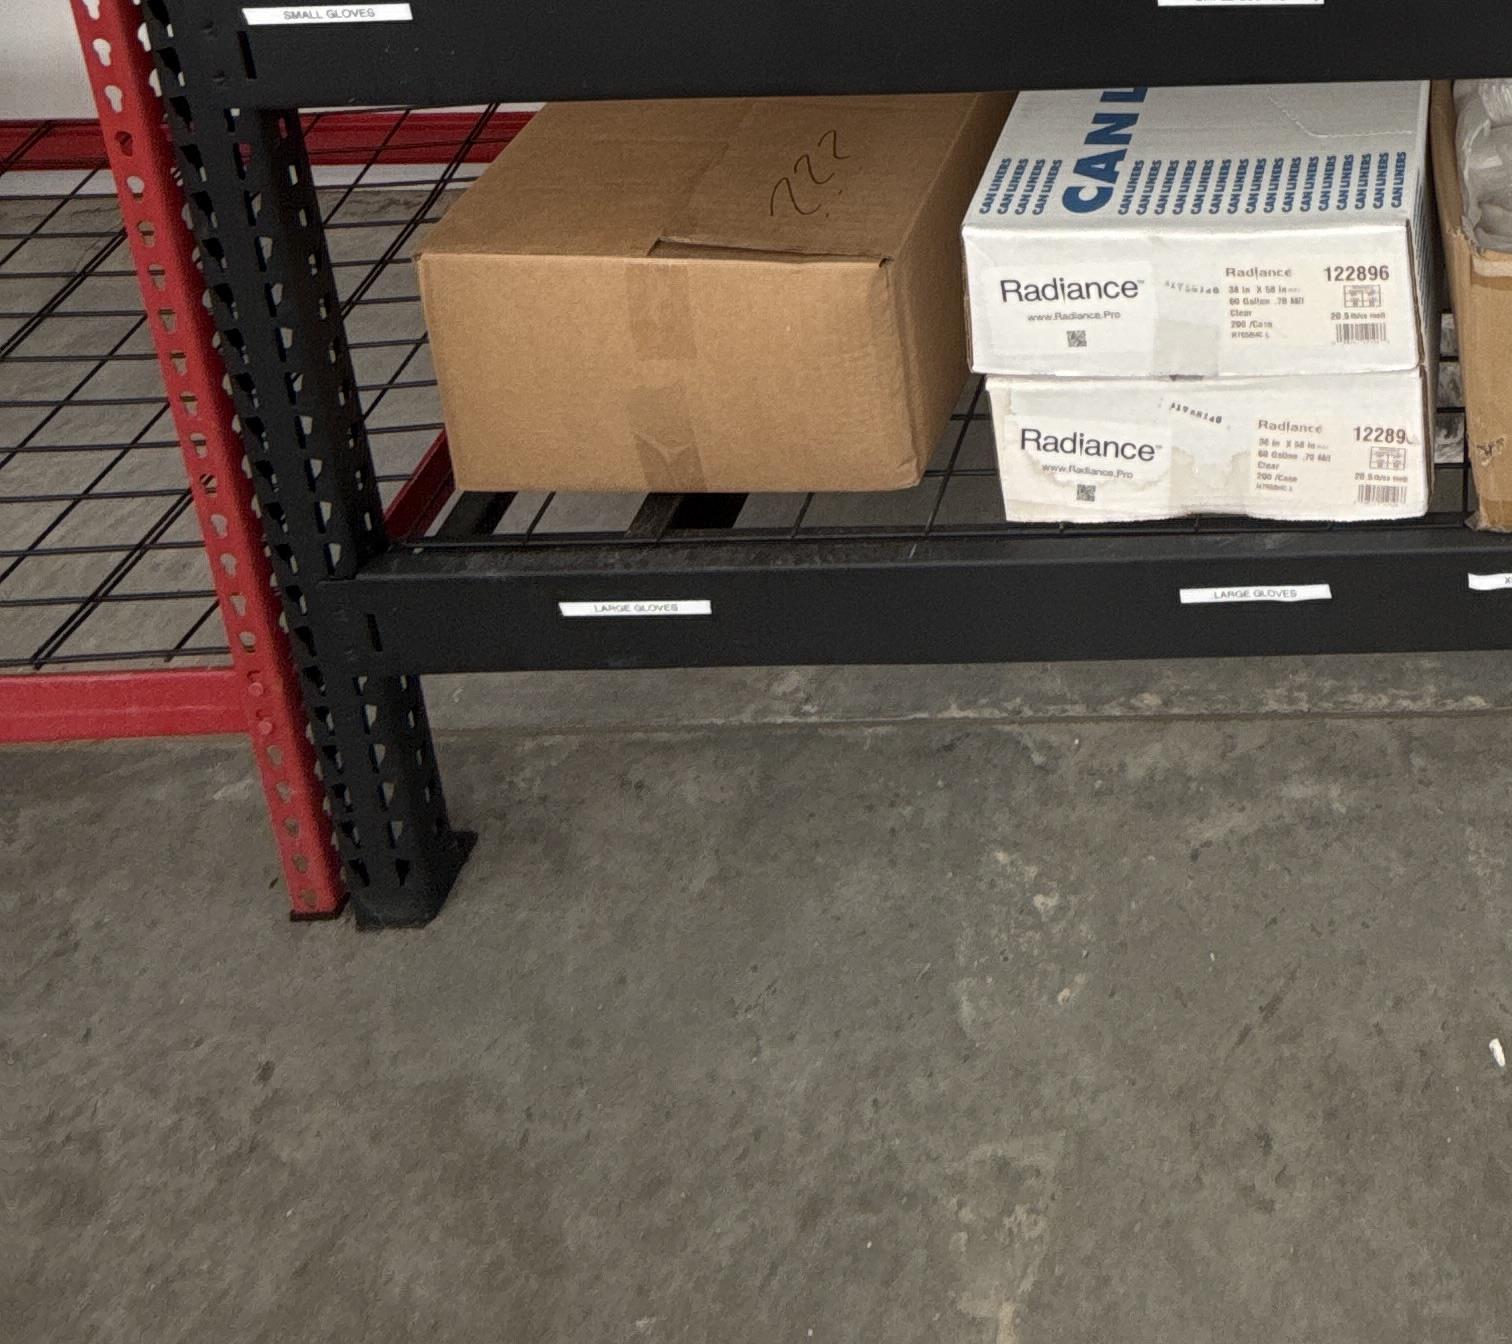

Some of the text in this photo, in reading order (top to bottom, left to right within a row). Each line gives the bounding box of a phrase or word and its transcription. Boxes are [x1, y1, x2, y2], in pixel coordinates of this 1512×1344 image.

[284, 8, 376, 20] SMALL GLOVES
[979, 158, 1012, 214] CAN LINERS
[997, 158, 1029, 214] CAN LINERS
[1015, 159, 1045, 215] CAN LINERS
[1032, 159, 1062, 215] CAN LINERS
[1062, 113, 1140, 214] CAN
[1118, 160, 1144, 215] CAN LINERS
[1136, 160, 1162, 215] CAN LINERS
[1154, 160, 1179, 215] CAN LINERS
[1172, 160, 1197, 215] CAN LINERS
[1191, 160, 1214, 214] CAN LINERS
[1209, 159, 1232, 214] CAN LINERS
[1227, 159, 1249, 214] CAN LINERS
[1245, 158, 1267, 213] CAN LINERS
[1264, 158, 1284, 213] CAN LINERS
[1282, 157, 1301, 212] CAN LINERS
[1300, 156, 1319, 212] CAN LINERS
[1318, 155, 1336, 211] CAN LINERS
[1336, 154, 1354, 211] CAN LINERS
[1355, 153, 1372, 209] CAN LINERS
[1373, 152, 1389, 209] CAN LINERS
[1391, 152, 1407, 208] CAN LINERS
[1225, 267, 1292, 280] Radiance
[1324, 265, 1390, 282] 122896
[1258, 419, 1323, 434] Radiance
[594, 604, 679, 613] LARGE GLOVES
[1213, 589, 1297, 599] LARGE GLOVES
